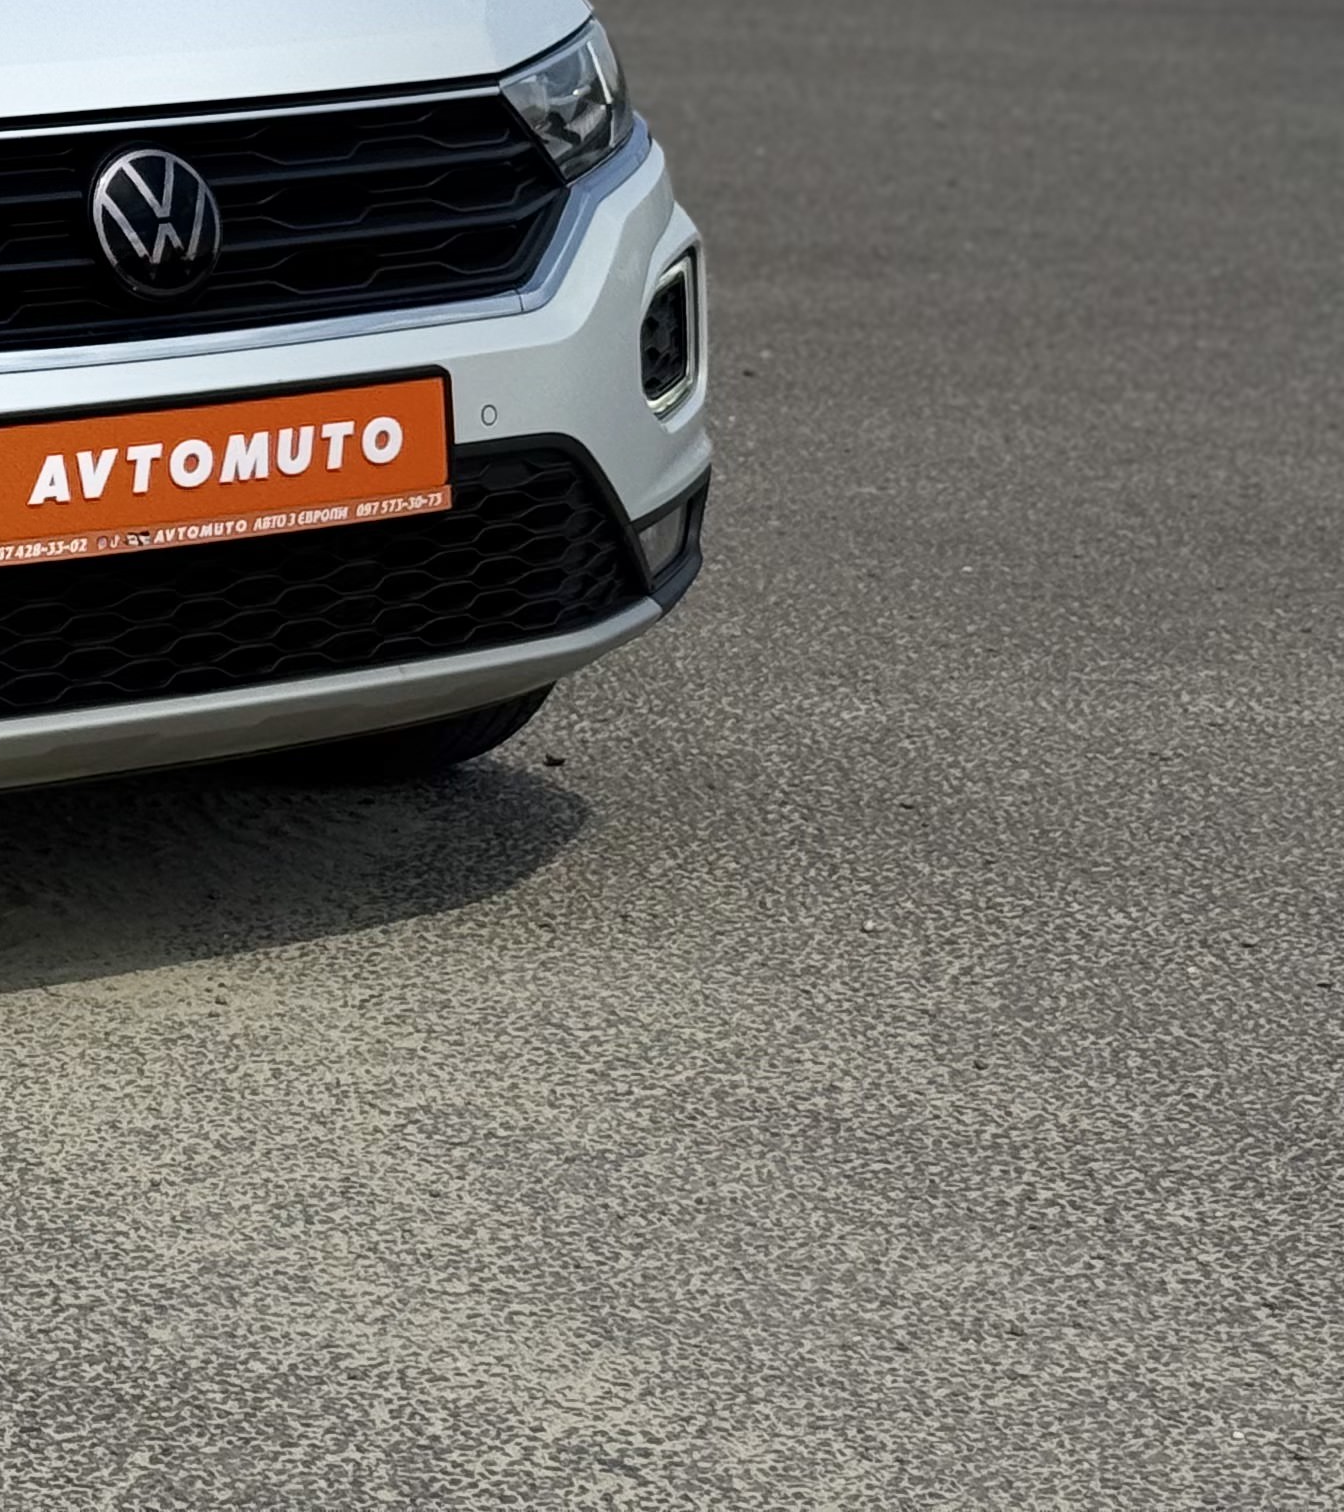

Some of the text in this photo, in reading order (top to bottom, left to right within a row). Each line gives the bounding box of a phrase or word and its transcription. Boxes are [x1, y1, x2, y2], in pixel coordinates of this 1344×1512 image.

[95, 150, 219, 292] VW
[27, 416, 404, 506] AVTOMUTO
[154, 519, 247, 544] AVTOMUTO
[253, 514, 285, 531] АВТО
[297, 506, 348, 525] ЄВРОПИ
